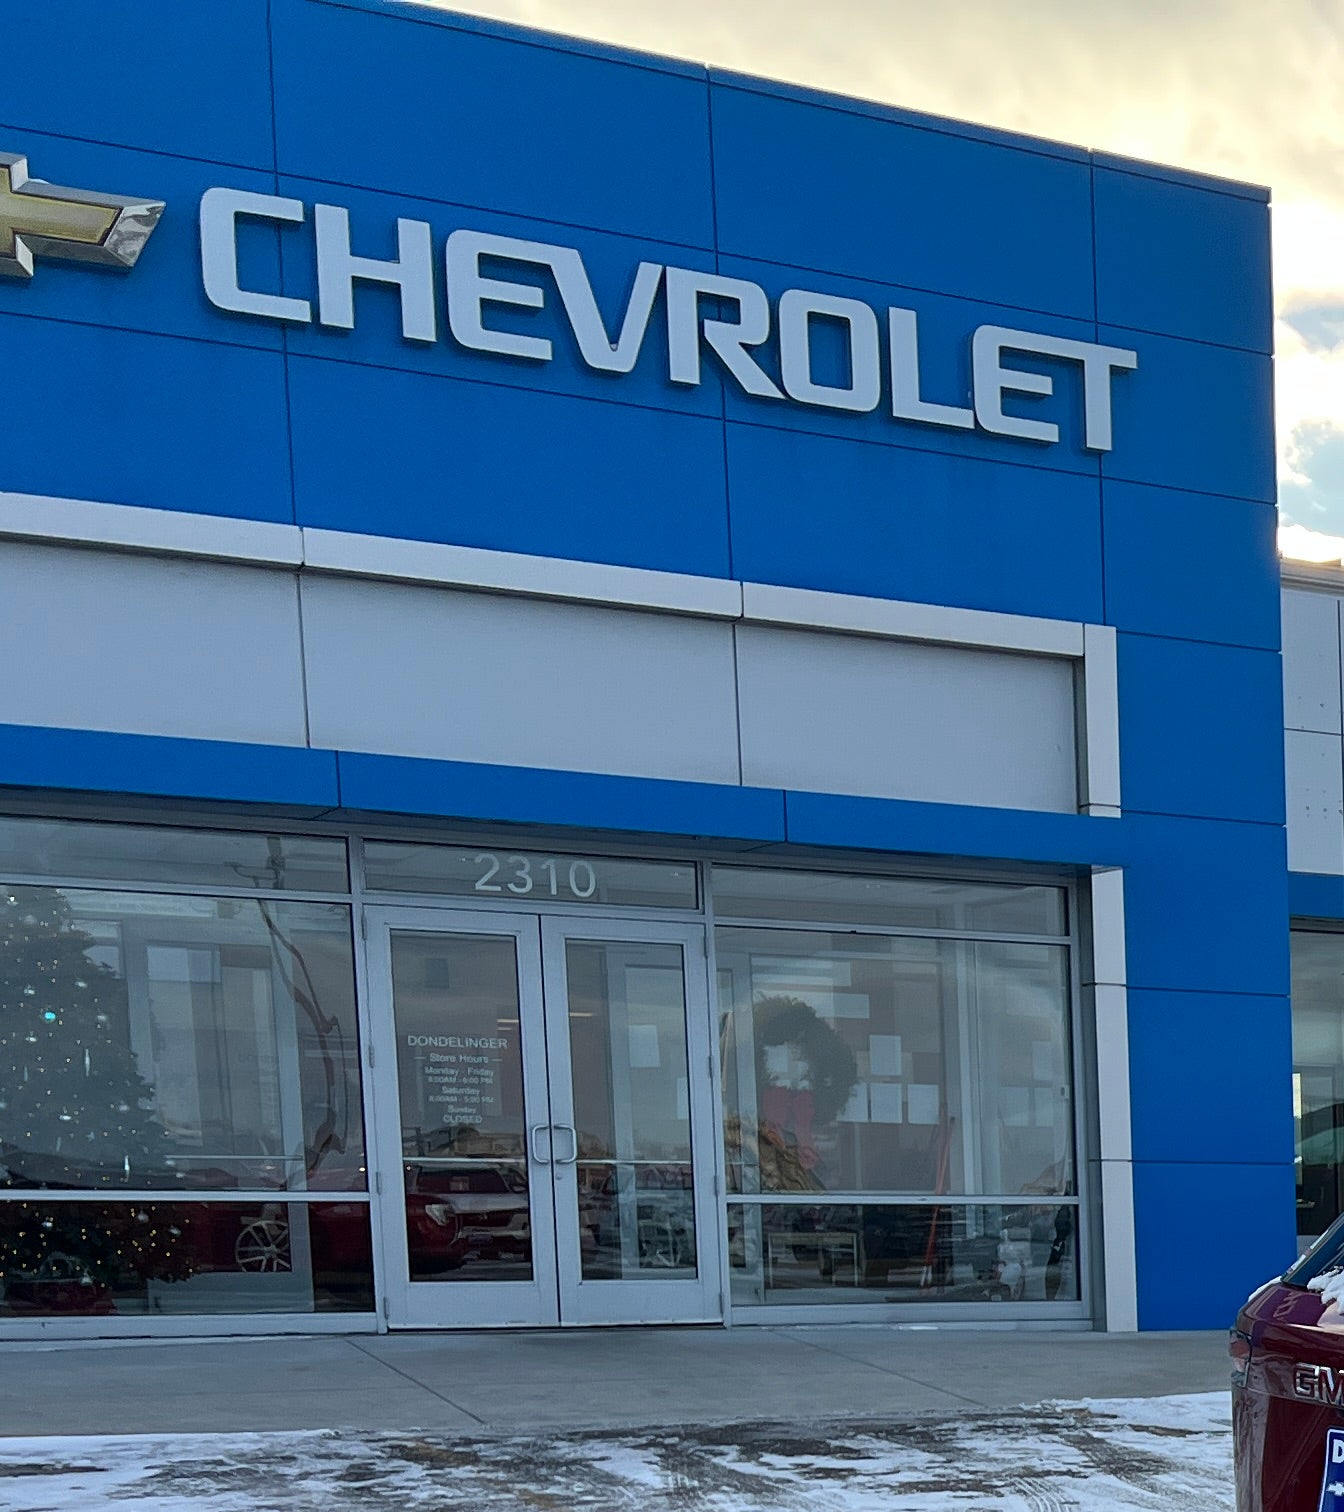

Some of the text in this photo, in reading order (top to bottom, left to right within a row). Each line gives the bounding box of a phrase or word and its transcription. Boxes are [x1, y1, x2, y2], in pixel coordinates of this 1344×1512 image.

[200, 186, 1138, 452] CHEVROLET
[474, 852, 596, 898] 2310
[407, 1035, 508, 1049] DONDELINGER
[429, 1053, 489, 1064] Store Hours
[443, 1114, 483, 1124] CLOSED
